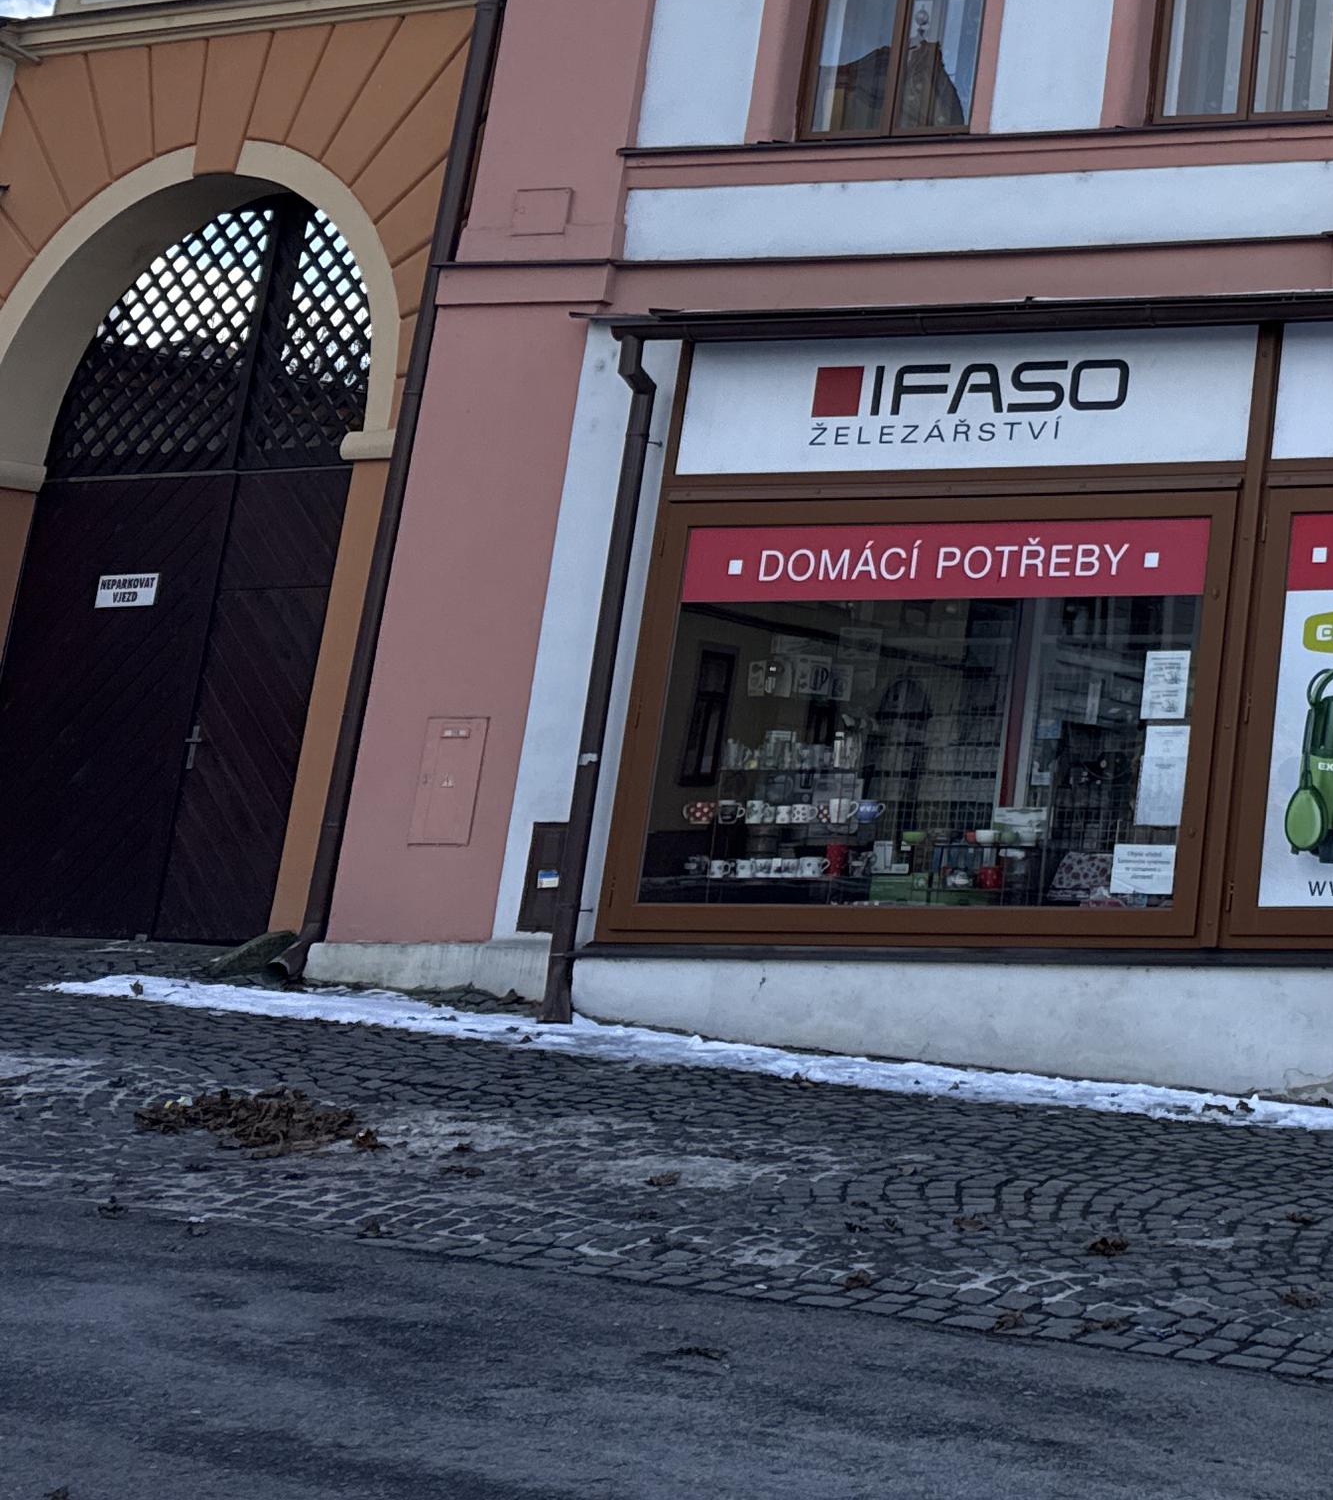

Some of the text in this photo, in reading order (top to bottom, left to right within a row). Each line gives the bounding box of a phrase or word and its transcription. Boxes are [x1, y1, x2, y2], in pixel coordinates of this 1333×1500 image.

[869, 358, 1131, 417] IFASO
[808, 415, 1062, 446] ŽELEZÁŘSTVÍ
[757, 537, 1131, 582] DOMÁCÍ POTŘEBY
[100, 577, 156, 590] NEPARKOVAT
[112, 591, 139, 603] VJEZD
